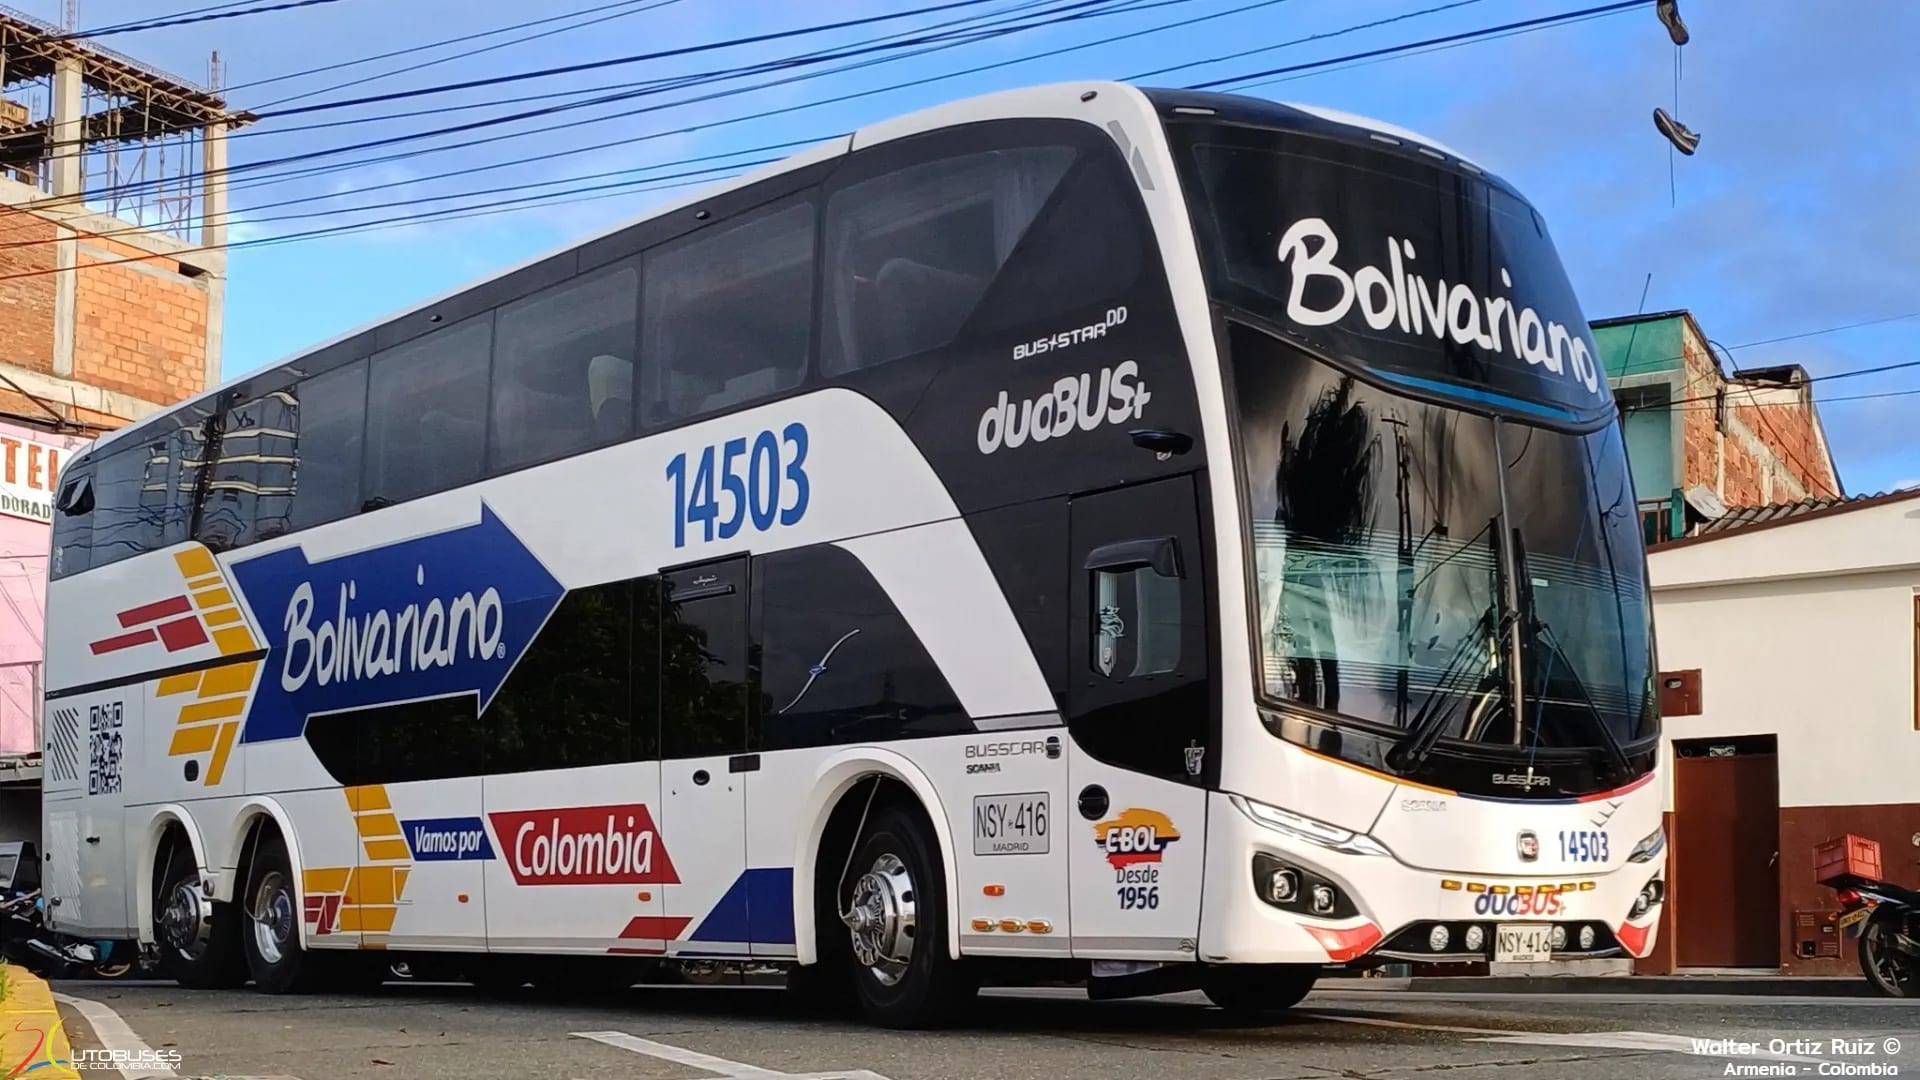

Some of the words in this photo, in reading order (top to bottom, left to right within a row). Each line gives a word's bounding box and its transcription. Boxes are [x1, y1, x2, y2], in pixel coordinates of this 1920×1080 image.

[1277, 217, 1598, 394] Bolivariano
[666, 422, 810, 548] 14503
[281, 564, 503, 692] Bolivariano
[965, 741, 1044, 758] BUSSCAR
[414, 826, 458, 853] Vamos
[458, 827, 483, 859] por
[515, 814, 653, 876] Colombia
[993, 842, 1029, 852] MADRID
[1105, 825, 1161, 853] EBOL
[1559, 831, 1609, 862] 14503
[1116, 866, 1159, 884] Desde
[1117, 886, 1159, 910] 1956
